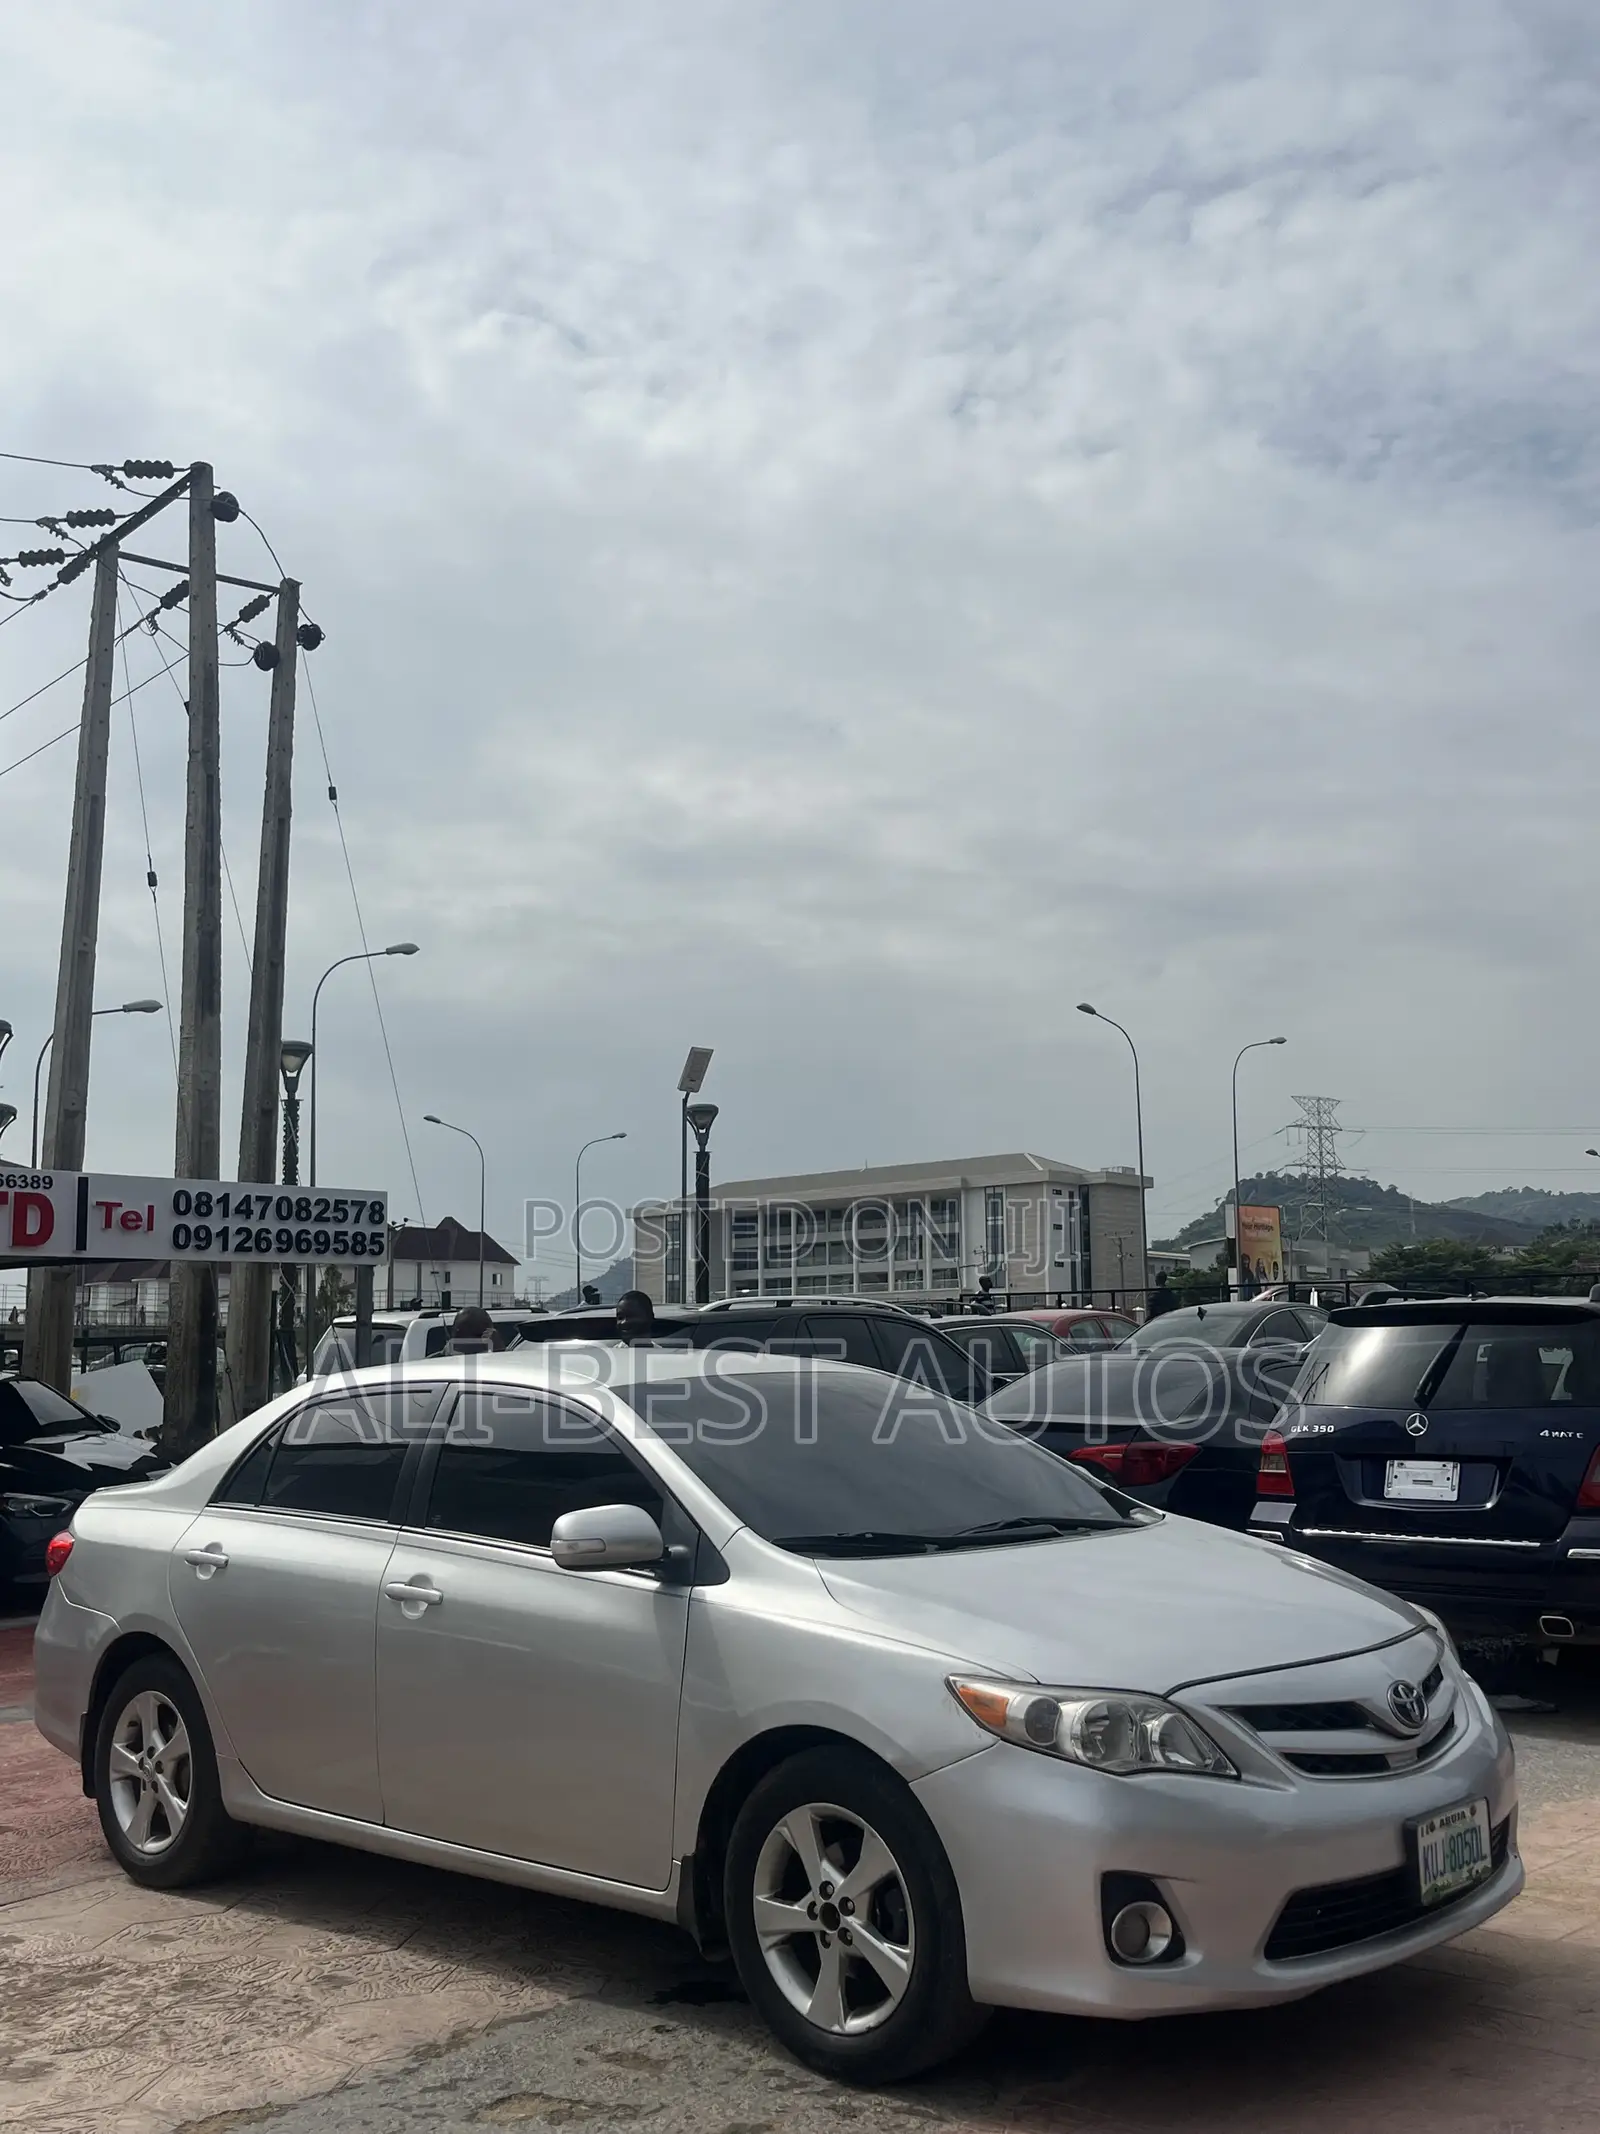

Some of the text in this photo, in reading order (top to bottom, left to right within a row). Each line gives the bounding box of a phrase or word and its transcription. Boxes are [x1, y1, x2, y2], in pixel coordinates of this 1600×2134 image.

[0, 1191, 55, 1246] D
[95, 1201, 154, 1231] Tel
[172, 1190, 385, 1224] 08147082578
[172, 1223, 385, 1256] 09126969585
[1290, 1424, 1335, 1433] GLK 350
[1539, 1429, 1584, 1439] 4MATC
